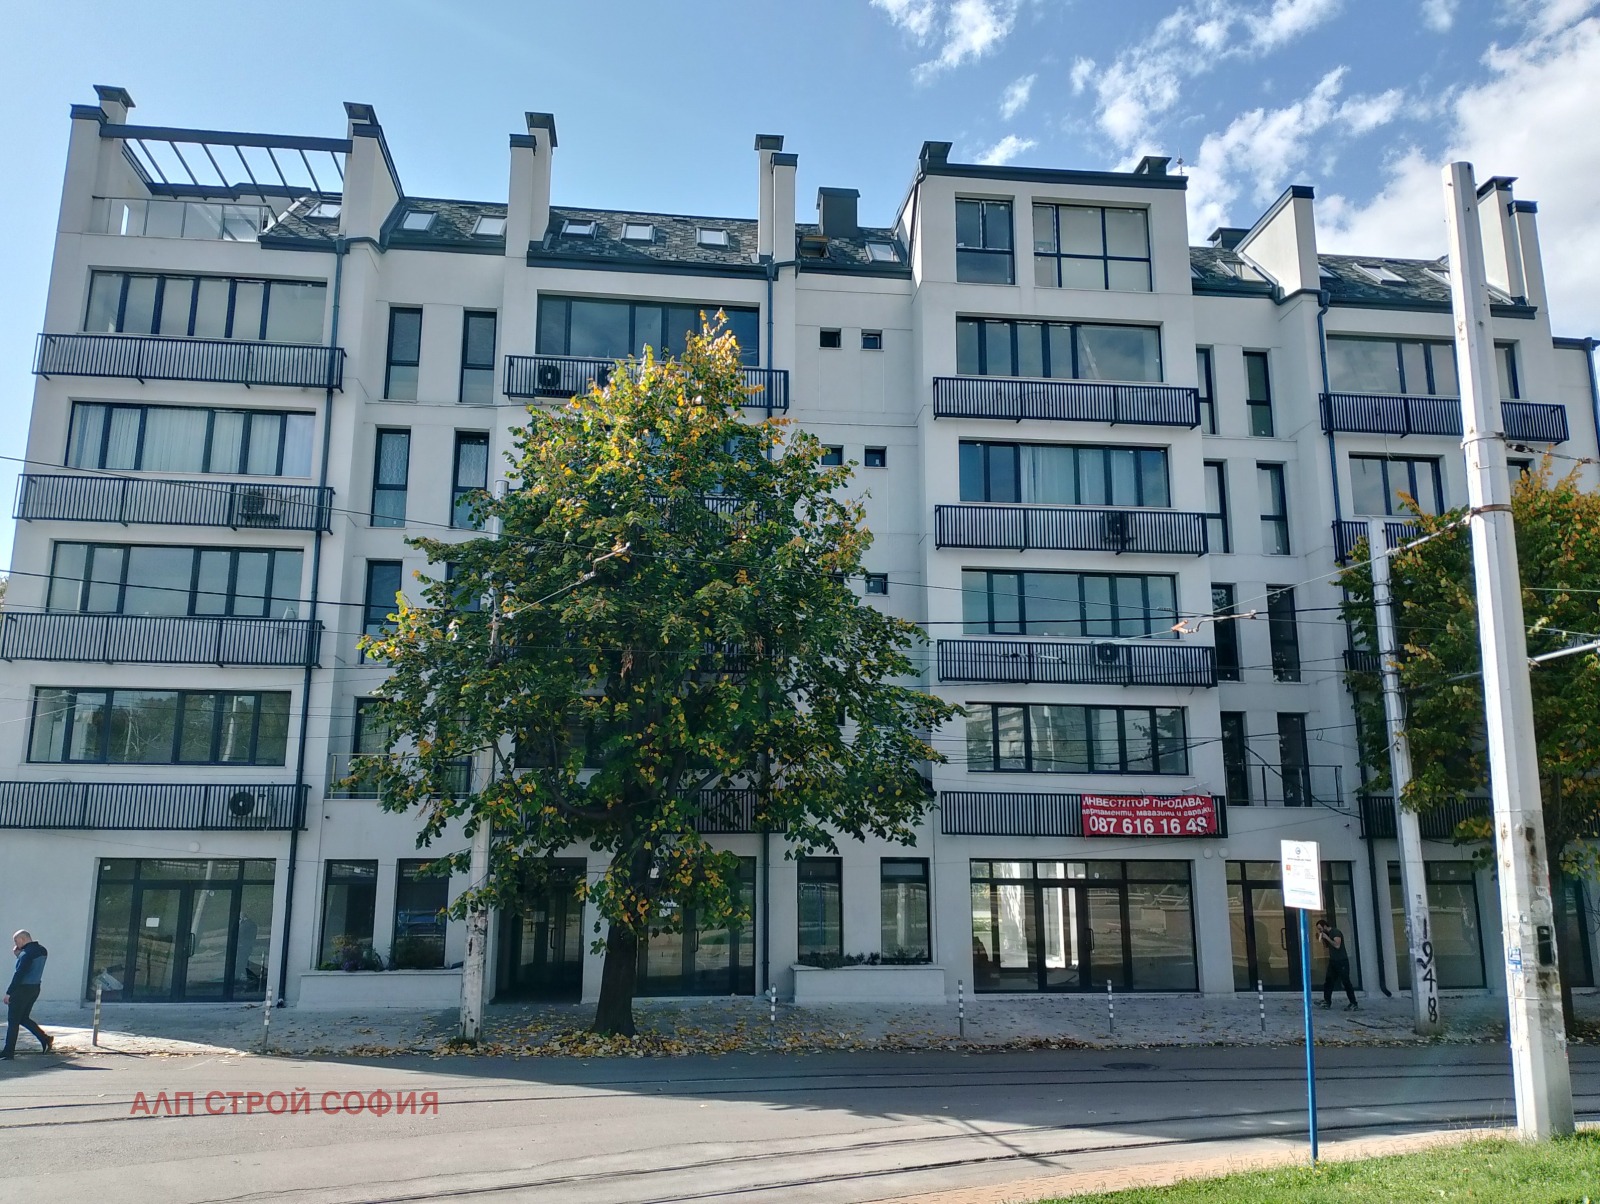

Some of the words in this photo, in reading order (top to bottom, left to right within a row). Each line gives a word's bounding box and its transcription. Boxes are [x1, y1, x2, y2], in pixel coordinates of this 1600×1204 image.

[1082, 796, 1150, 808] ИНВЕСТИТОР
[1152, 797, 1205, 809] ПРОДАВА:
[1089, 815, 1118, 833] 087
[1122, 818, 1155, 834] 616
[1160, 818, 1181, 834] 16
[1185, 816, 1208, 833] 48
